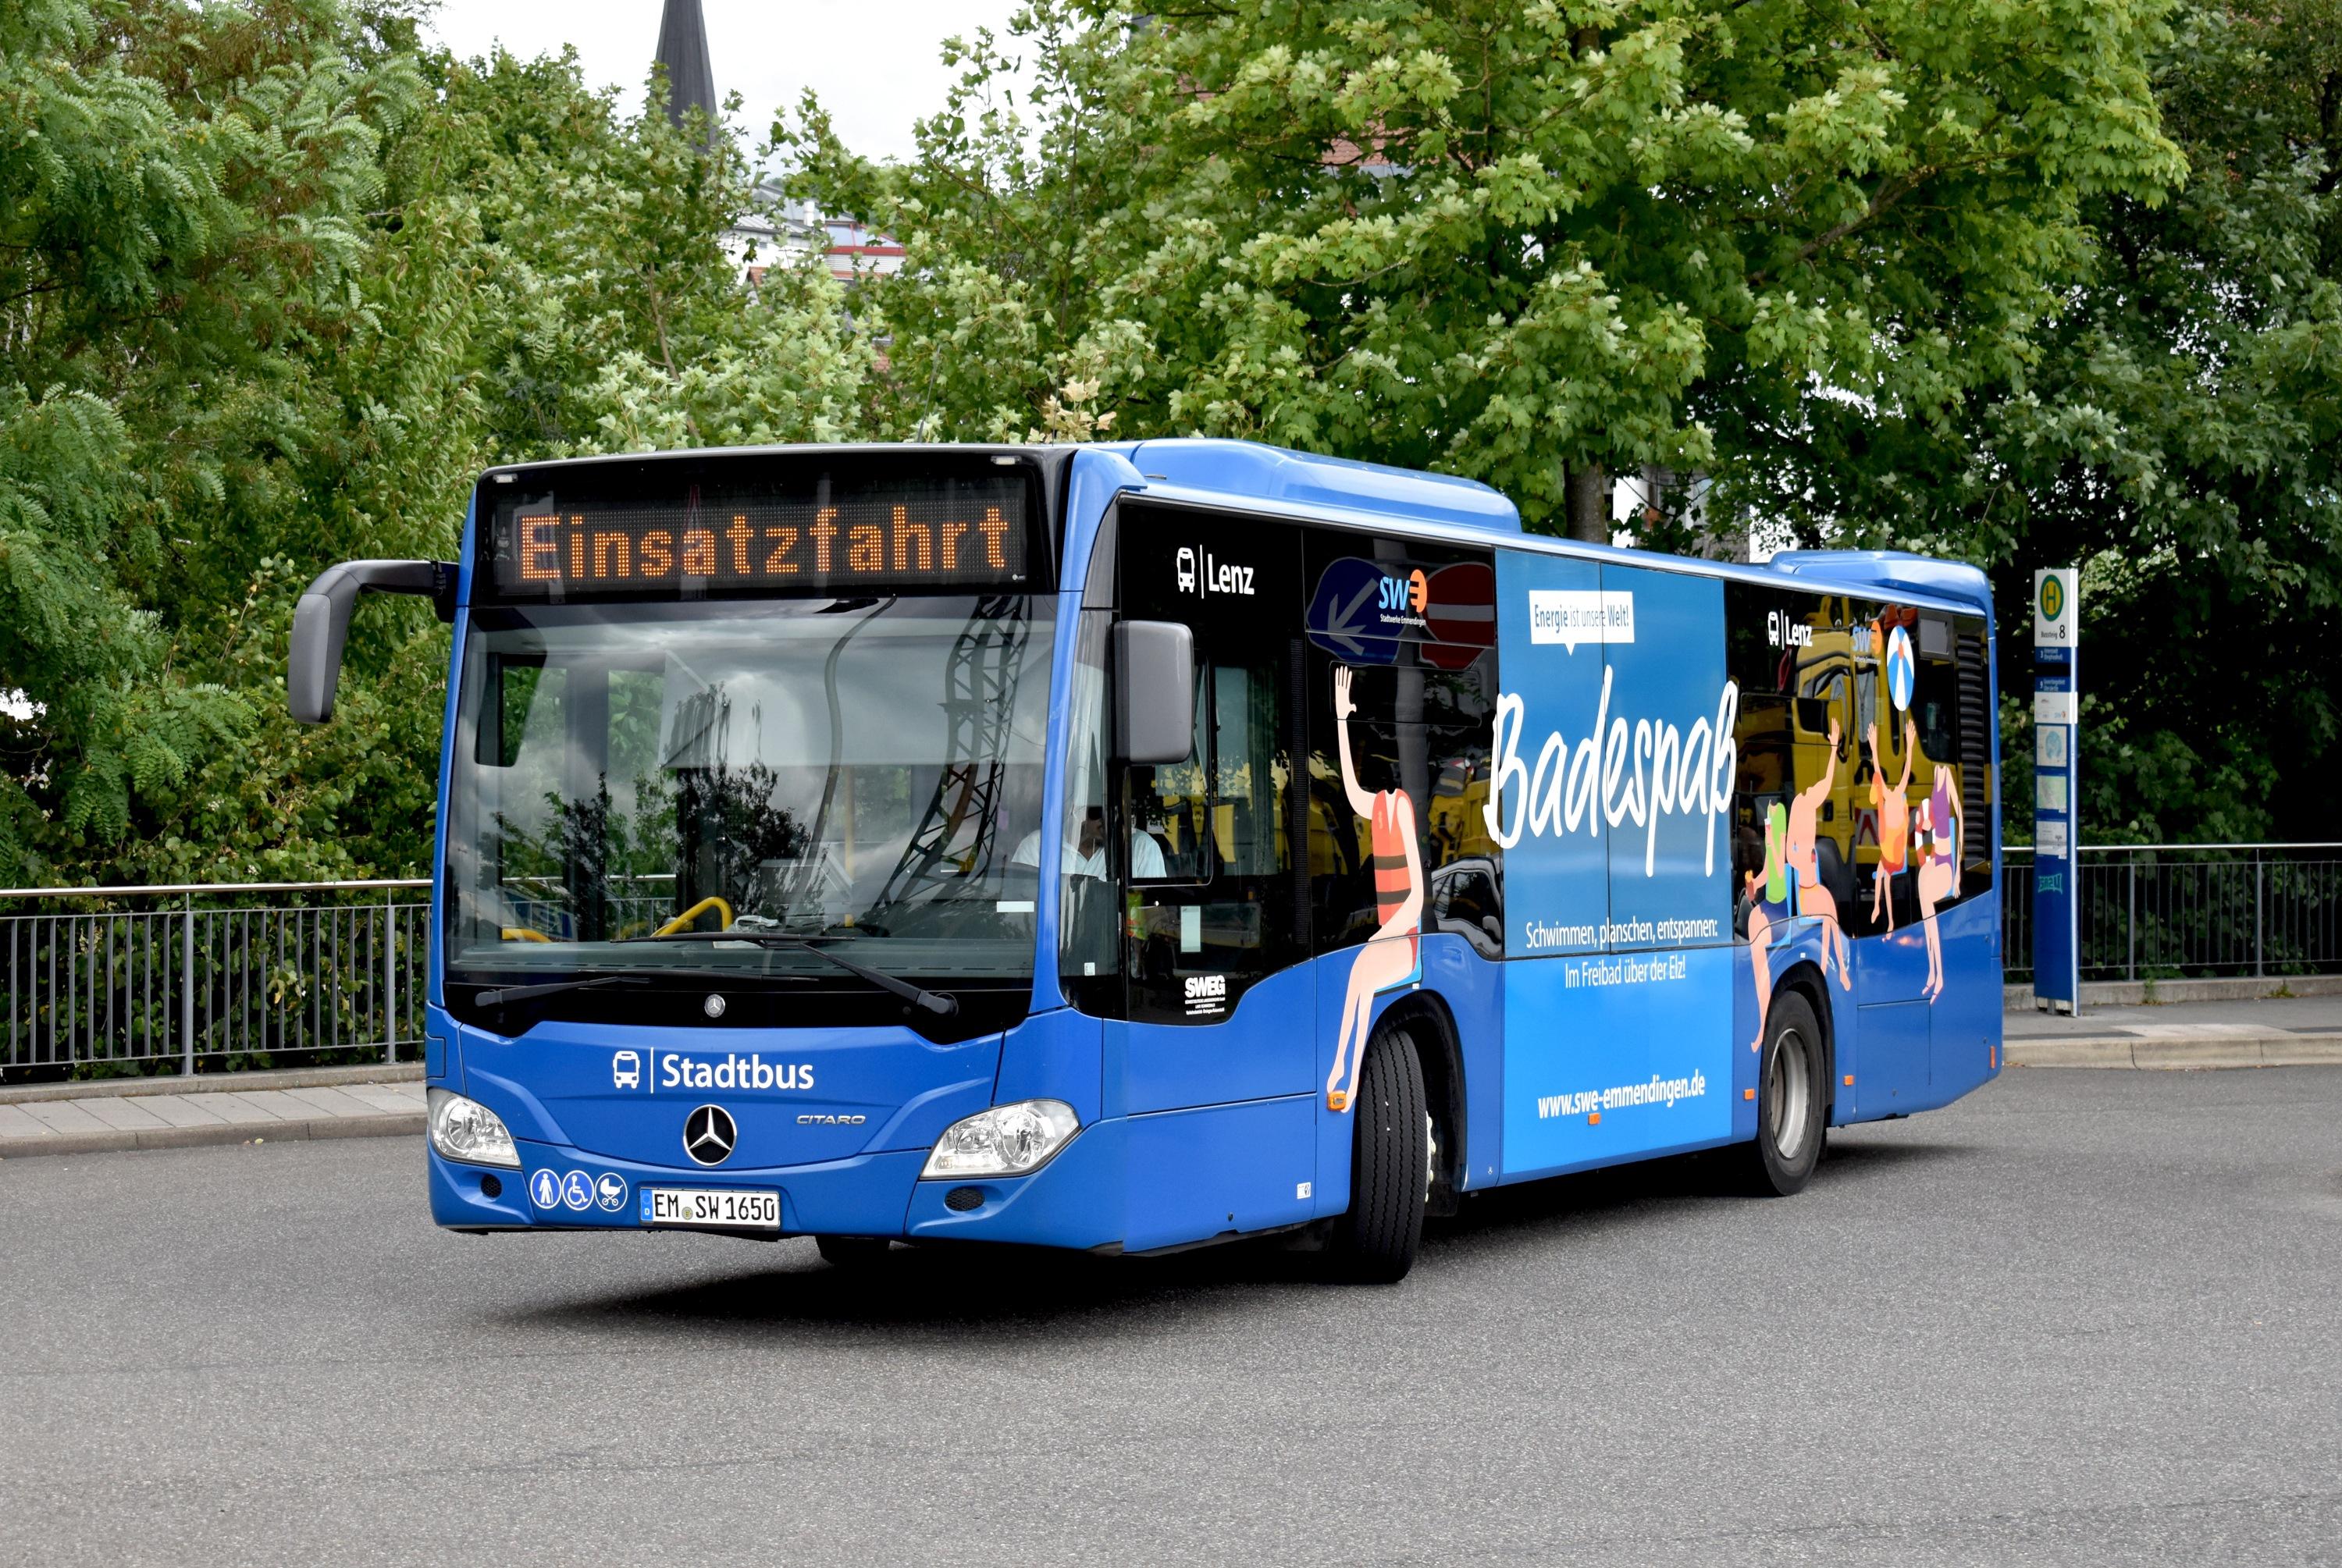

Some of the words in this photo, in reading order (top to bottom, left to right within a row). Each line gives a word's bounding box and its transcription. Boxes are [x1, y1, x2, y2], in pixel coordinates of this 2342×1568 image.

[520, 505, 1009, 579] Einsatzfahrt
[1207, 553, 1255, 596] Lenz
[1379, 613, 1401, 624] Stadtwerke
[1401, 615, 1426, 628] Emmendingen
[1534, 604, 1568, 634] Energie
[1570, 605, 1580, 628] ist
[1581, 610, 1606, 628] unsere
[1607, 603, 1629, 628] Welt!
[1785, 615, 1813, 648] Lenz
[2059, 624, 2066, 639] 8
[1482, 664, 1739, 878] Badespaß
[1525, 919, 1598, 948] Schwimmen,
[1599, 916, 1656, 950] planschen,
[1657, 917, 1718, 945] entspannen:
[1184, 975, 1226, 998] SWEG
[1564, 962, 1580, 988] Im
[1582, 958, 1622, 987] Freibad
[1624, 959, 1649, 984] über
[1650, 955, 1668, 982] der
[1668, 955, 1686, 980] Elz!
[661, 1053, 815, 1090] Stadtbus
[1537, 1068, 1706, 1119] www.swe-emmendingen.de
[796, 1115, 867, 1125] CITARO
[653, 1193, 680, 1218] EM
[695, 1195, 720, 1220] SW
[724, 1196, 775, 1221] 1650
